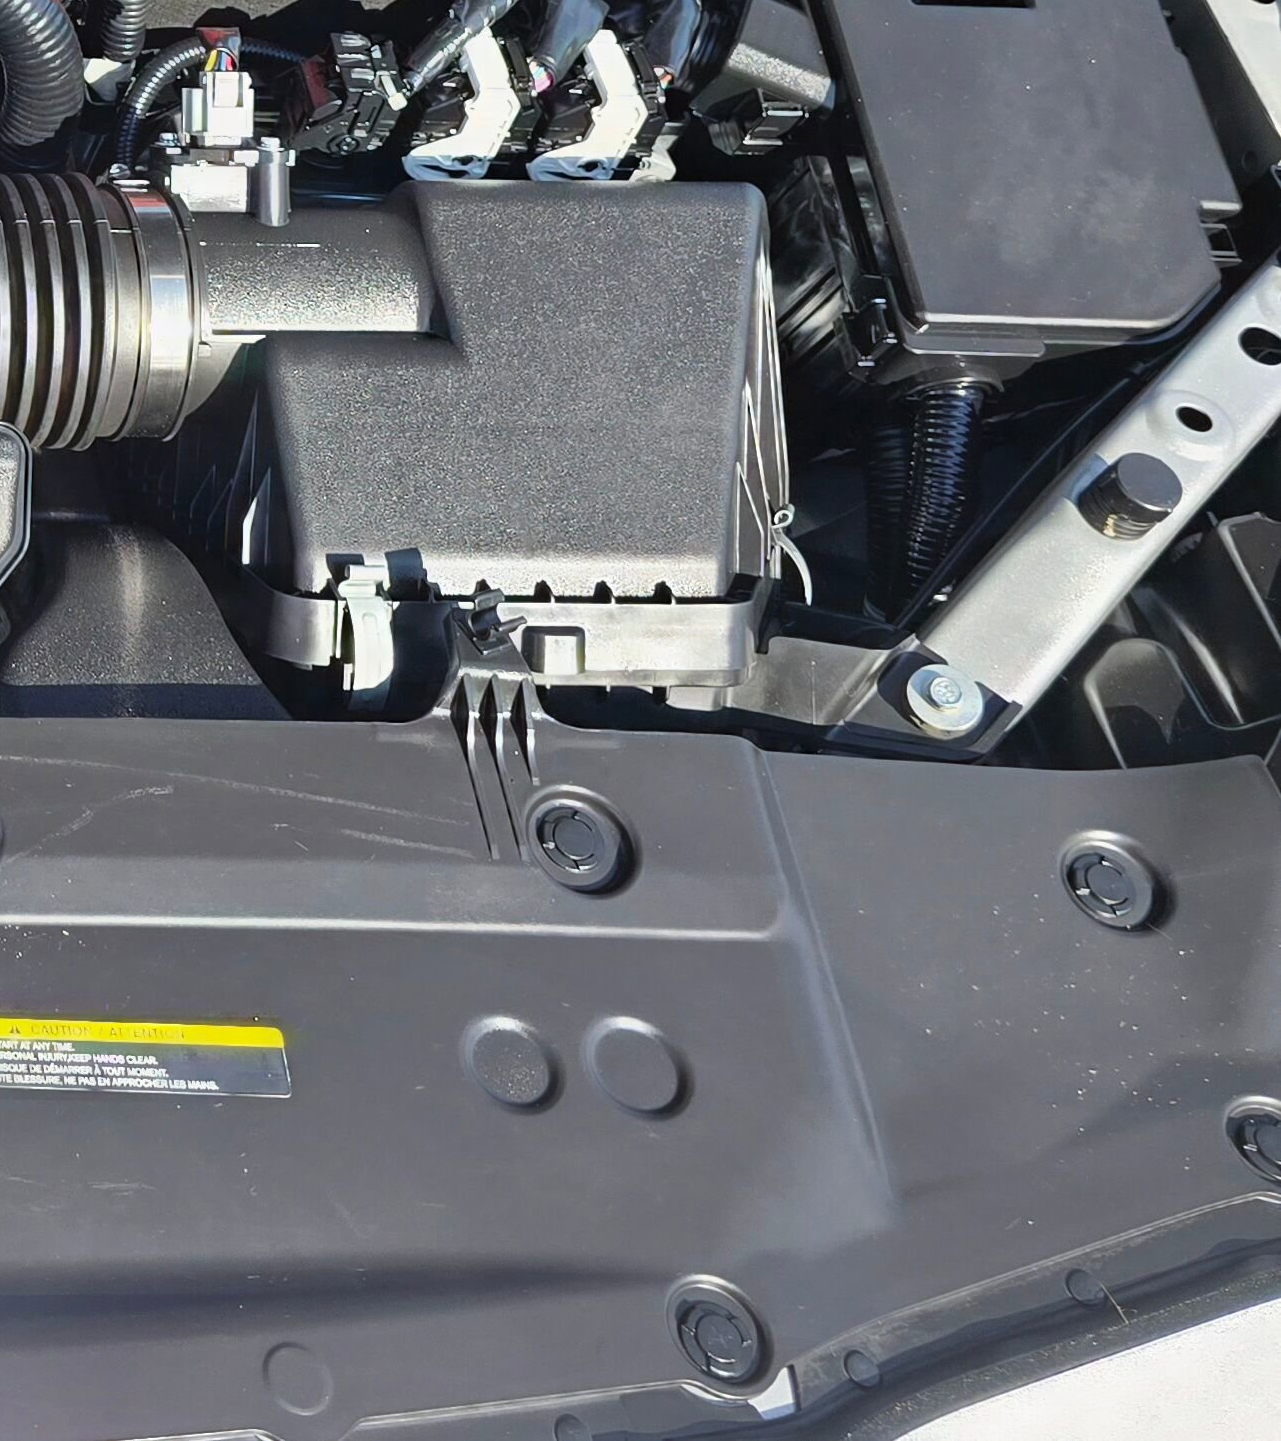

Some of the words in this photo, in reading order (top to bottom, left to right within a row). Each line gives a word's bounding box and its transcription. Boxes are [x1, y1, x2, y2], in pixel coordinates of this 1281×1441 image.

[31, 1025, 92, 1037] CAUTION
[109, 1027, 187, 1039] ATENTIN
[20, 1041, 31, 1050] AT
[32, 1041, 50, 1051] ANY
[93, 1054, 125, 1064] HANDS
[30, 1064, 42, 1073] DE
[44, 1063, 93, 1075] DÉMARRER
[102, 1066, 125, 1076] TOUT
[64, 1076, 77, 1086] NE
[79, 1076, 96, 1086] PAS
[98, 1077, 110, 1087] EN
[112, 1078, 168, 1089] APPROCHER
[169, 1079, 187, 1089] LES
